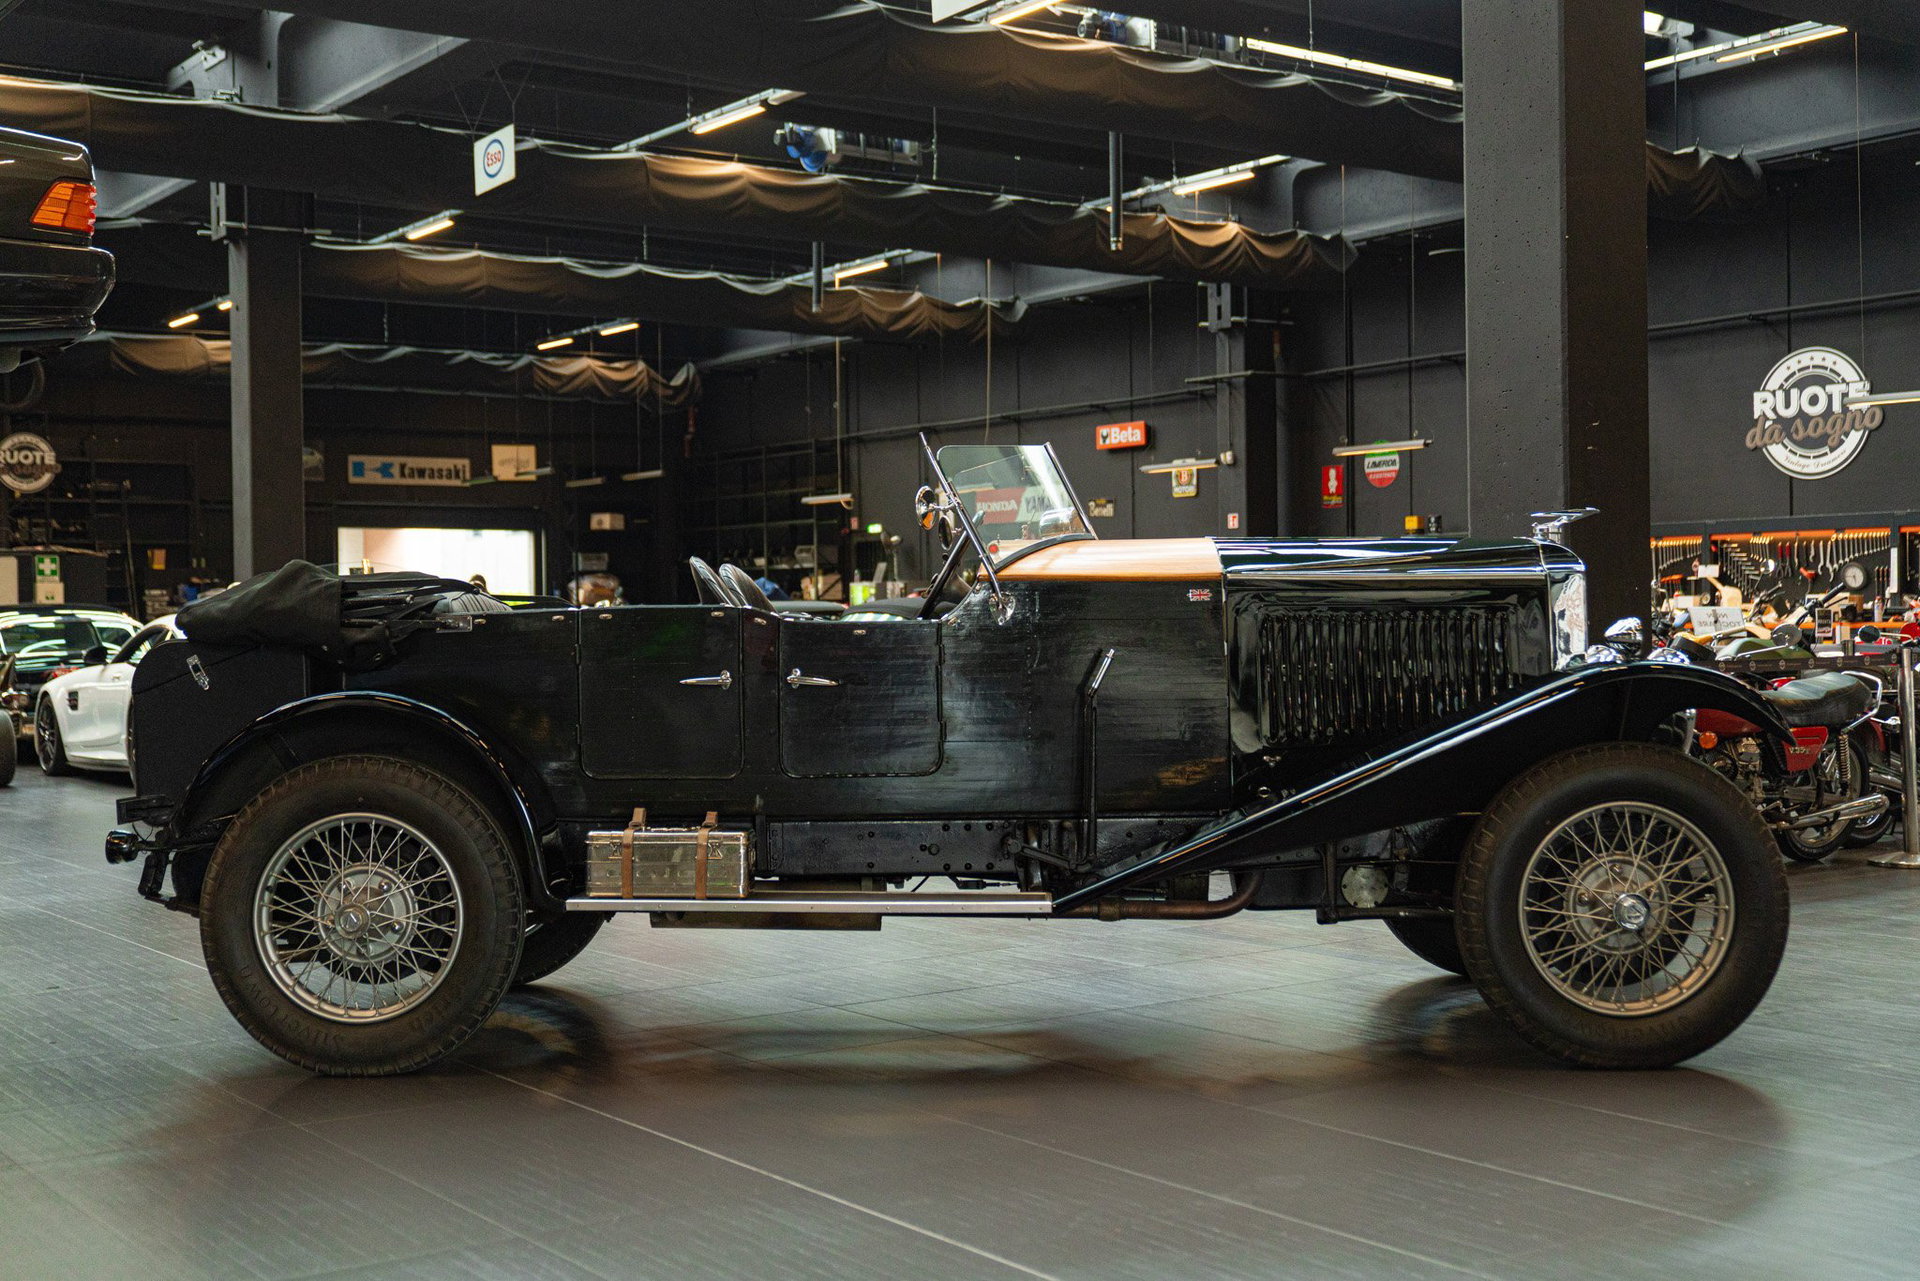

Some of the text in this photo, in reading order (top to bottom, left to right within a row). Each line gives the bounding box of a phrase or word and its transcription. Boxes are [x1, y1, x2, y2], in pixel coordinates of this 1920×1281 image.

[486, 149, 502, 168] Esso
[1753, 380, 1871, 420] RUOTE
[1110, 426, 1142, 444] Beta
[1745, 406, 1884, 450] da sogno
[399, 463, 467, 482] Kawasaki
[976, 499, 1018, 513] HONDA
